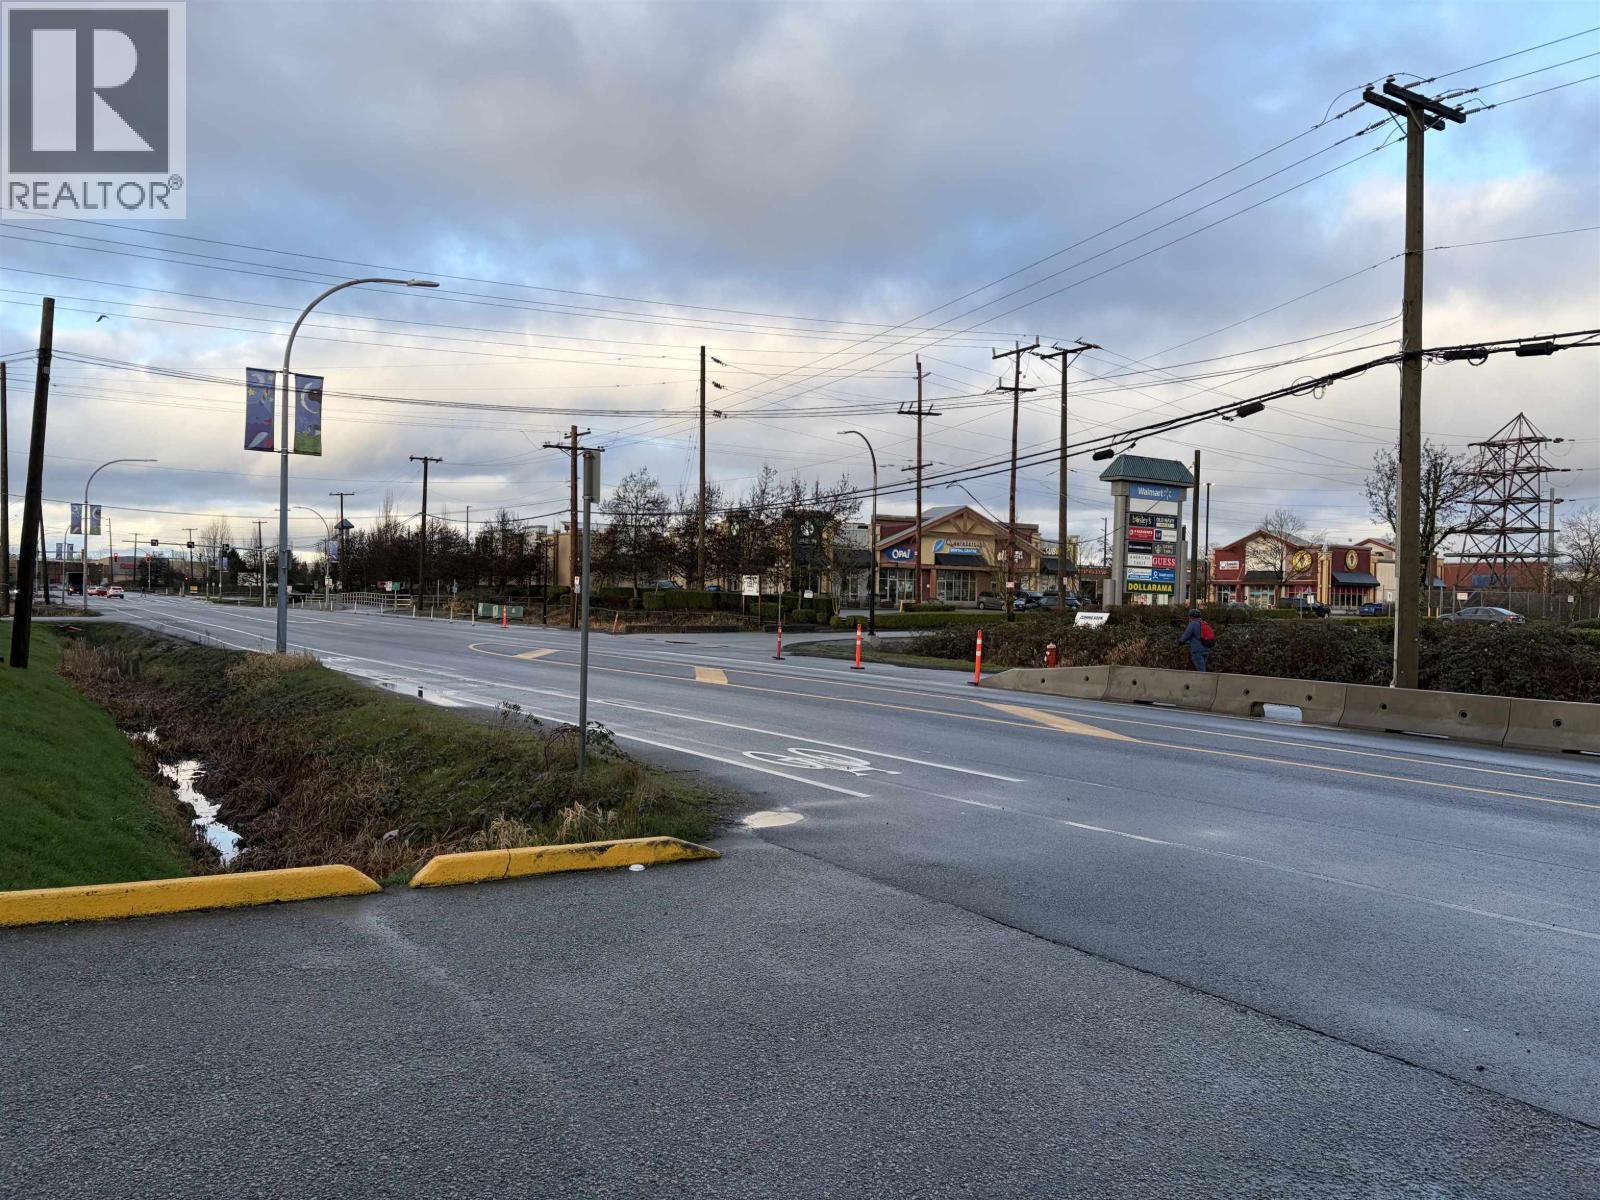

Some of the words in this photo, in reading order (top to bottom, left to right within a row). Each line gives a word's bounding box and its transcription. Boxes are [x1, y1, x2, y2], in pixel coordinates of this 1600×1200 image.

[1137, 487, 1163, 497] Walmart
[892, 549, 911, 559] OPA!
[1152, 557, 1176, 566] GUESS
[1128, 583, 1172, 592] DOLLARAMA
